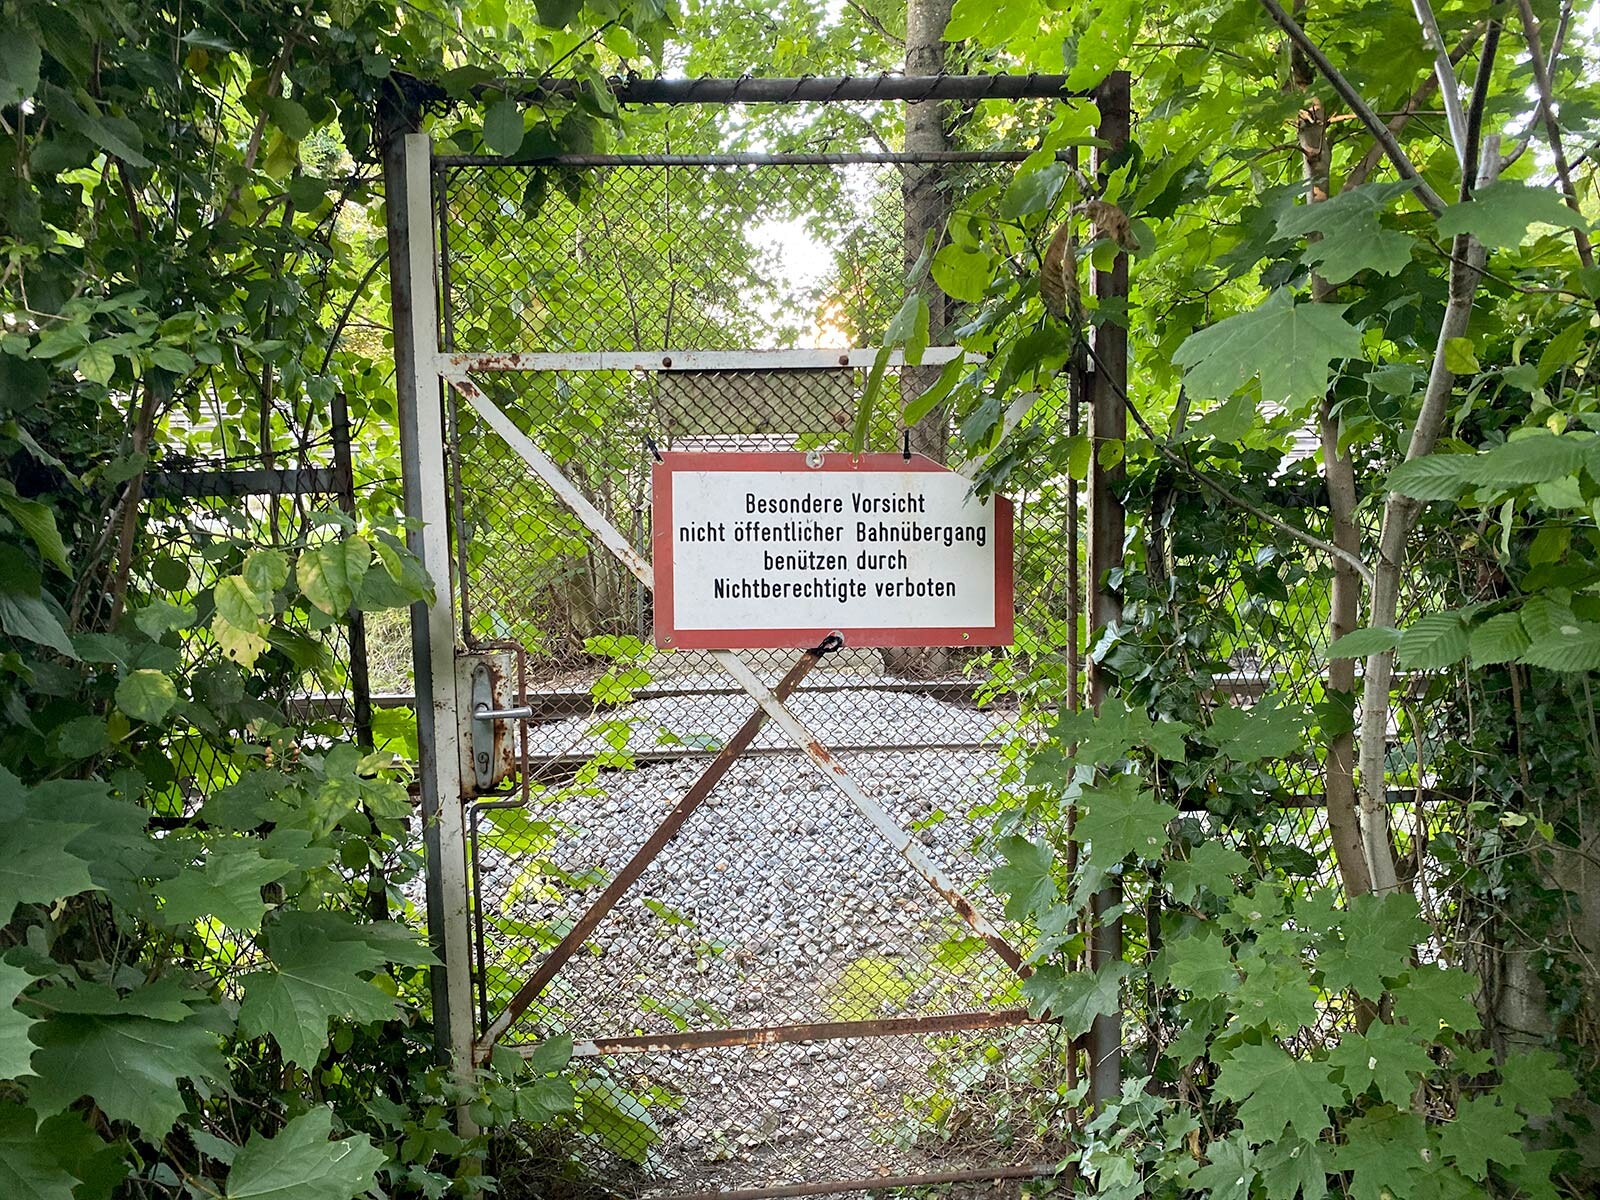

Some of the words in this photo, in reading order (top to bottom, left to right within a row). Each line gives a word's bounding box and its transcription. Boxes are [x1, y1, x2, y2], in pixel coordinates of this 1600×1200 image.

[746, 492, 844, 515] Besondere
[851, 492, 925, 514] Vorsicht
[679, 521, 726, 543] nicht
[734, 521, 844, 543] öffentlicher
[856, 521, 986, 547] Bahnübergang
[764, 549, 847, 571] benützen
[856, 549, 907, 570] durch
[714, 577, 867, 603] Nichtberechtigte
[874, 576, 956, 598] verboten
